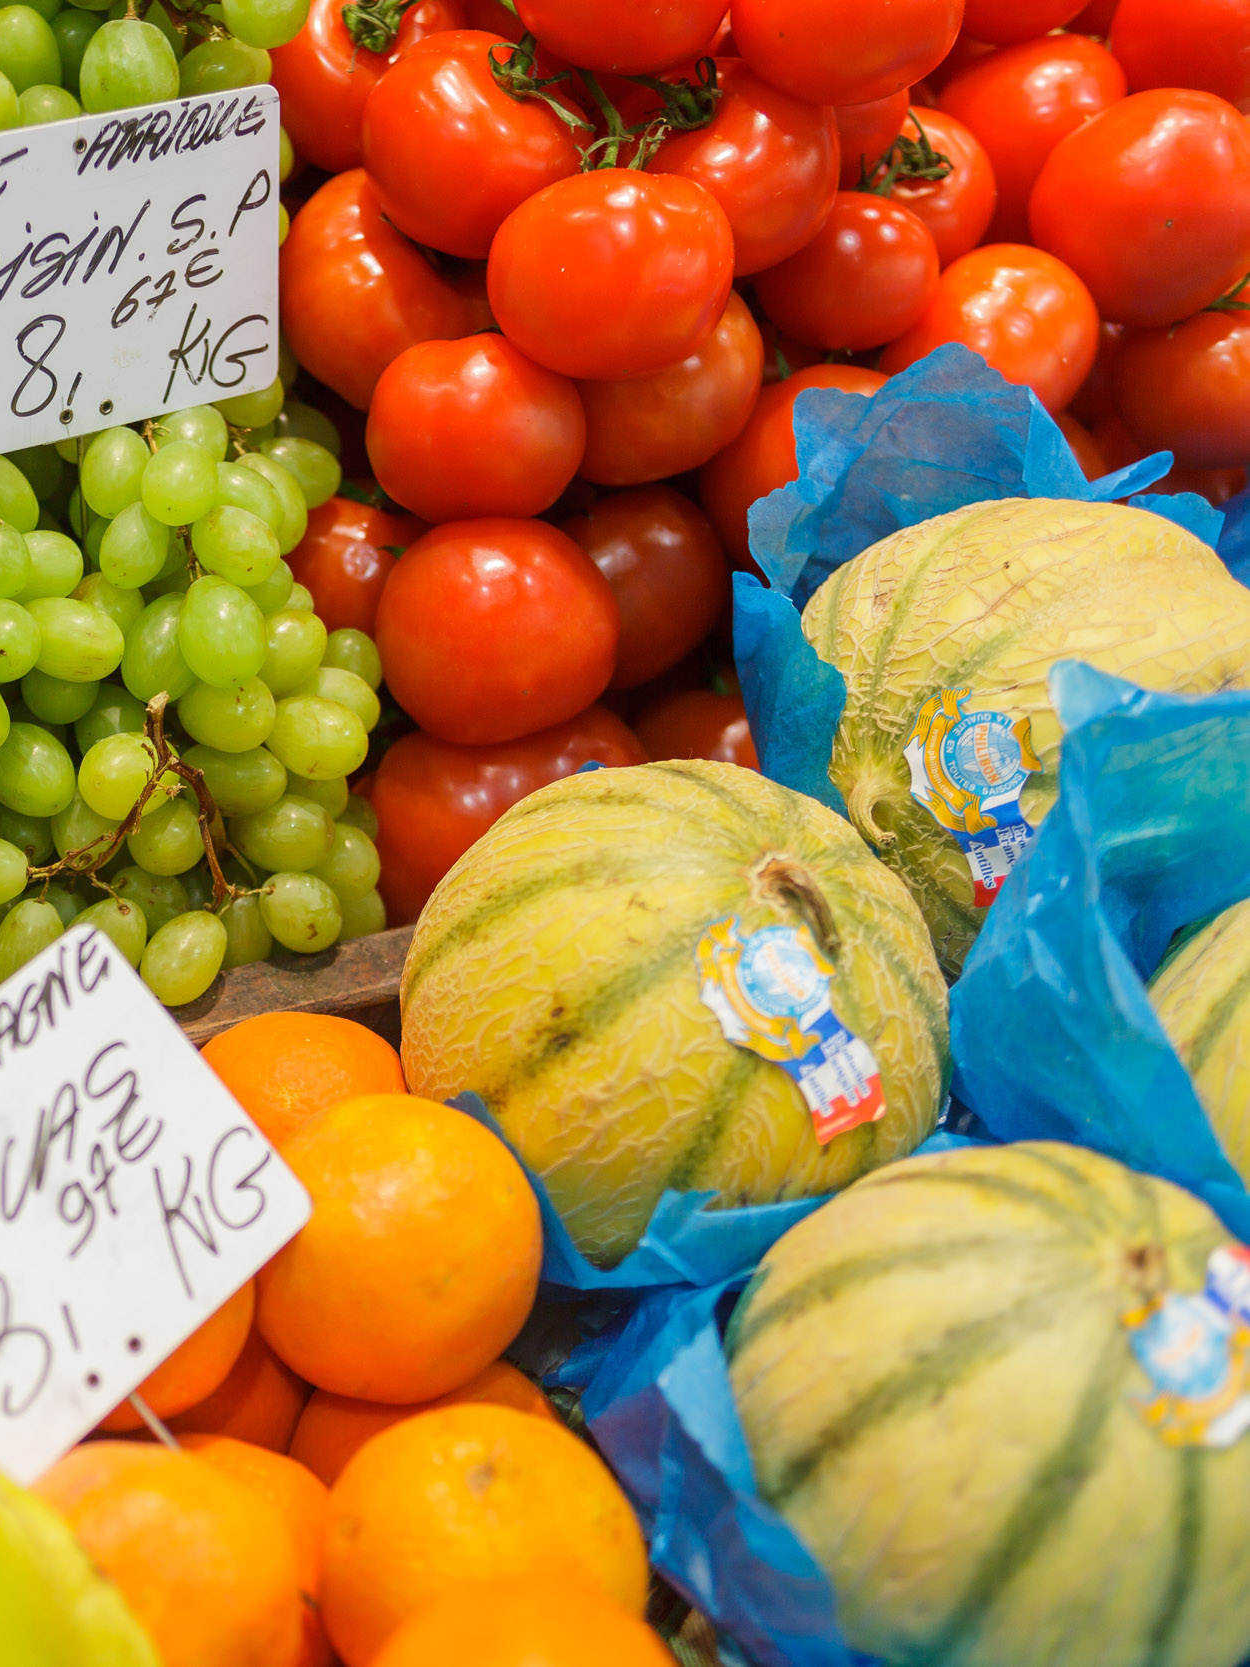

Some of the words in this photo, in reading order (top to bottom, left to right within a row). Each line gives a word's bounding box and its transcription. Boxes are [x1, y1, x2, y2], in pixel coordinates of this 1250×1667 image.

[163, 302, 269, 404] KG
[947, 760, 976, 791] TOUTES
[982, 774, 1023, 795] SAISONS
[975, 724, 1002, 784] PHILIBON
[969, 841, 996, 889] Antilles
[996, 827, 1016, 865] Franç
[152, 1125, 273, 1301] KG
